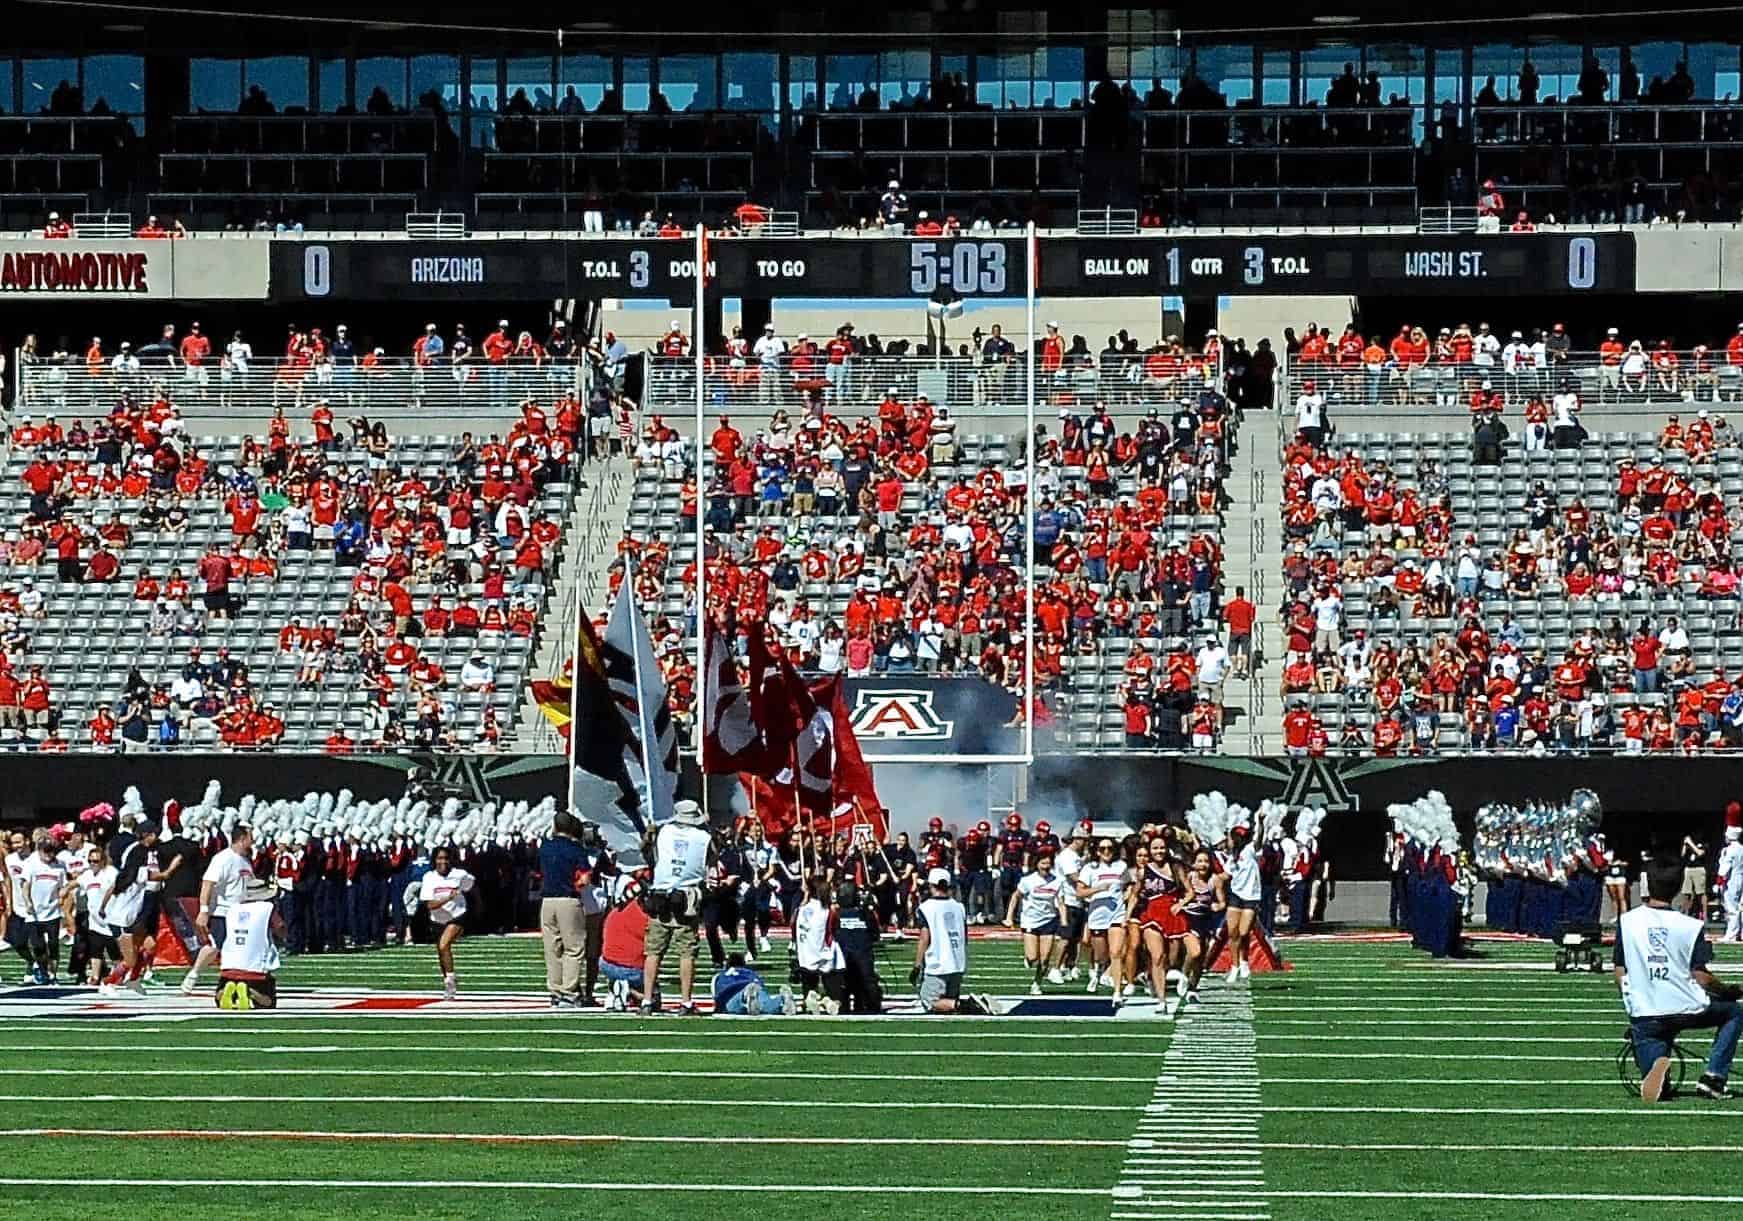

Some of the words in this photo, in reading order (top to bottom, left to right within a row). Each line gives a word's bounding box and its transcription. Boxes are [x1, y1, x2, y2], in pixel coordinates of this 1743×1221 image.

[2, 252, 148, 292] AUTOMOTIVE
[304, 245, 331, 295] 0
[411, 257, 484, 283] ARIZONA
[630, 251, 649, 288] 3
[757, 261, 778, 277] TO
[782, 260, 805, 277] GO
[911, 243, 1006, 292] 5:03
[1085, 259, 1123, 276] BALL
[1126, 259, 1149, 276] ON
[1166, 248, 1179, 286] 1
[1191, 258, 1223, 275] QTR
[1244, 248, 1264, 285] 3
[1405, 252, 1453, 277] WASH
[1458, 252, 1488, 277] ST.
[1568, 237, 1596, 289] 0
[848, 689, 954, 740] A
[1649, 967, 1670, 981] 142
